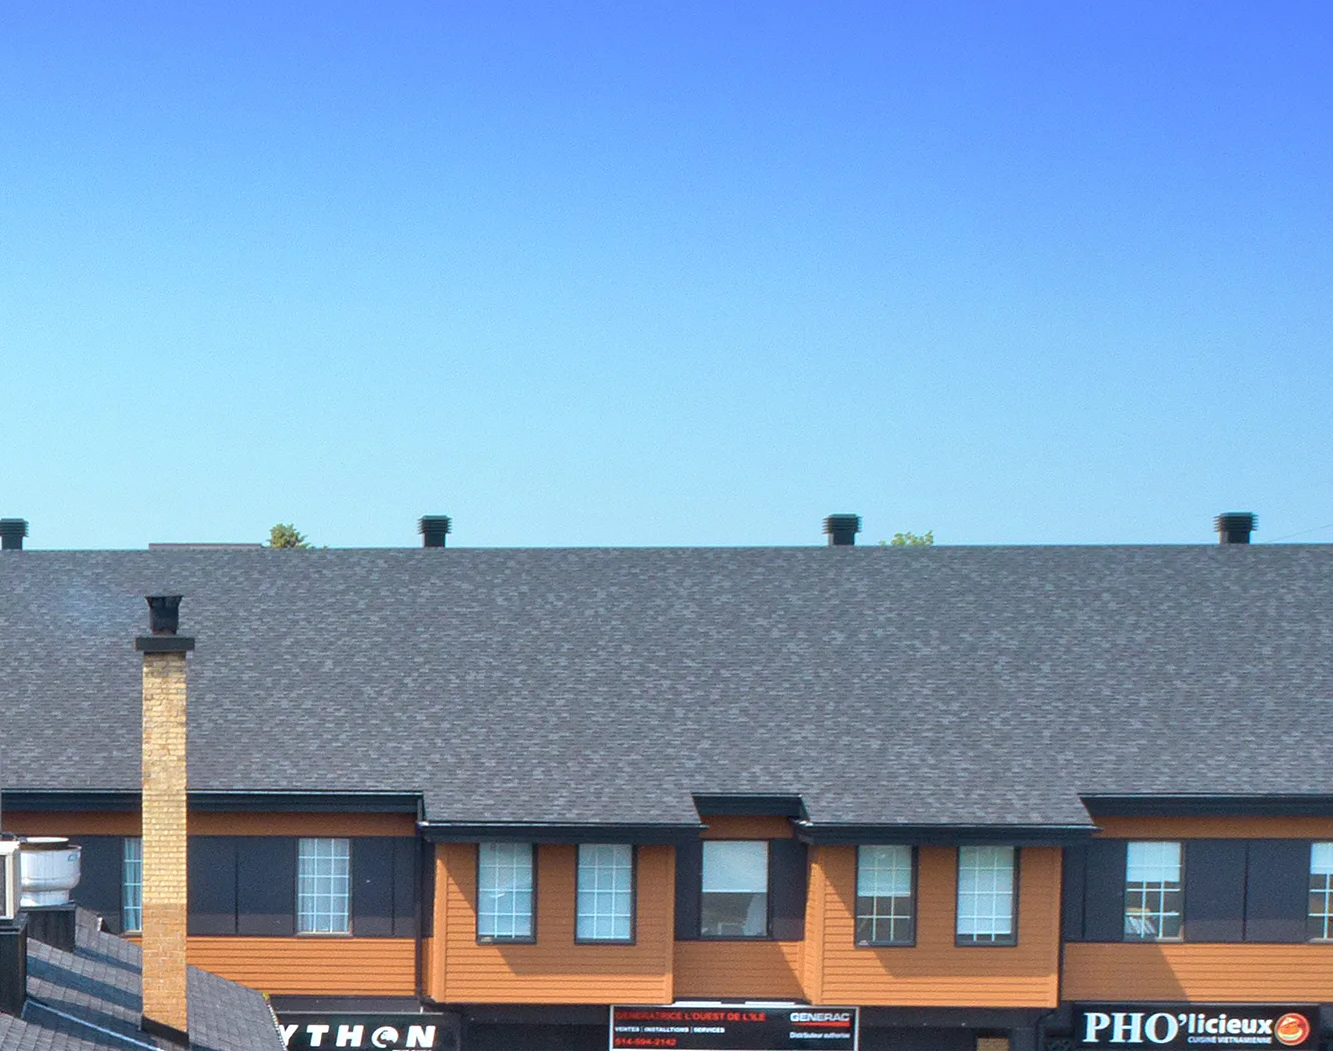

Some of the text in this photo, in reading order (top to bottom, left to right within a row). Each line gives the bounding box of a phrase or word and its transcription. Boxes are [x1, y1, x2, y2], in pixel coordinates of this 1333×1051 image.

[726, 1012, 741, 1021] DE
[790, 1012, 850, 1022] GENERAC
[693, 1026, 726, 1034] SERVICES
[1187, 1036, 1272, 1045] CUISINE VIETNAMIENNE
